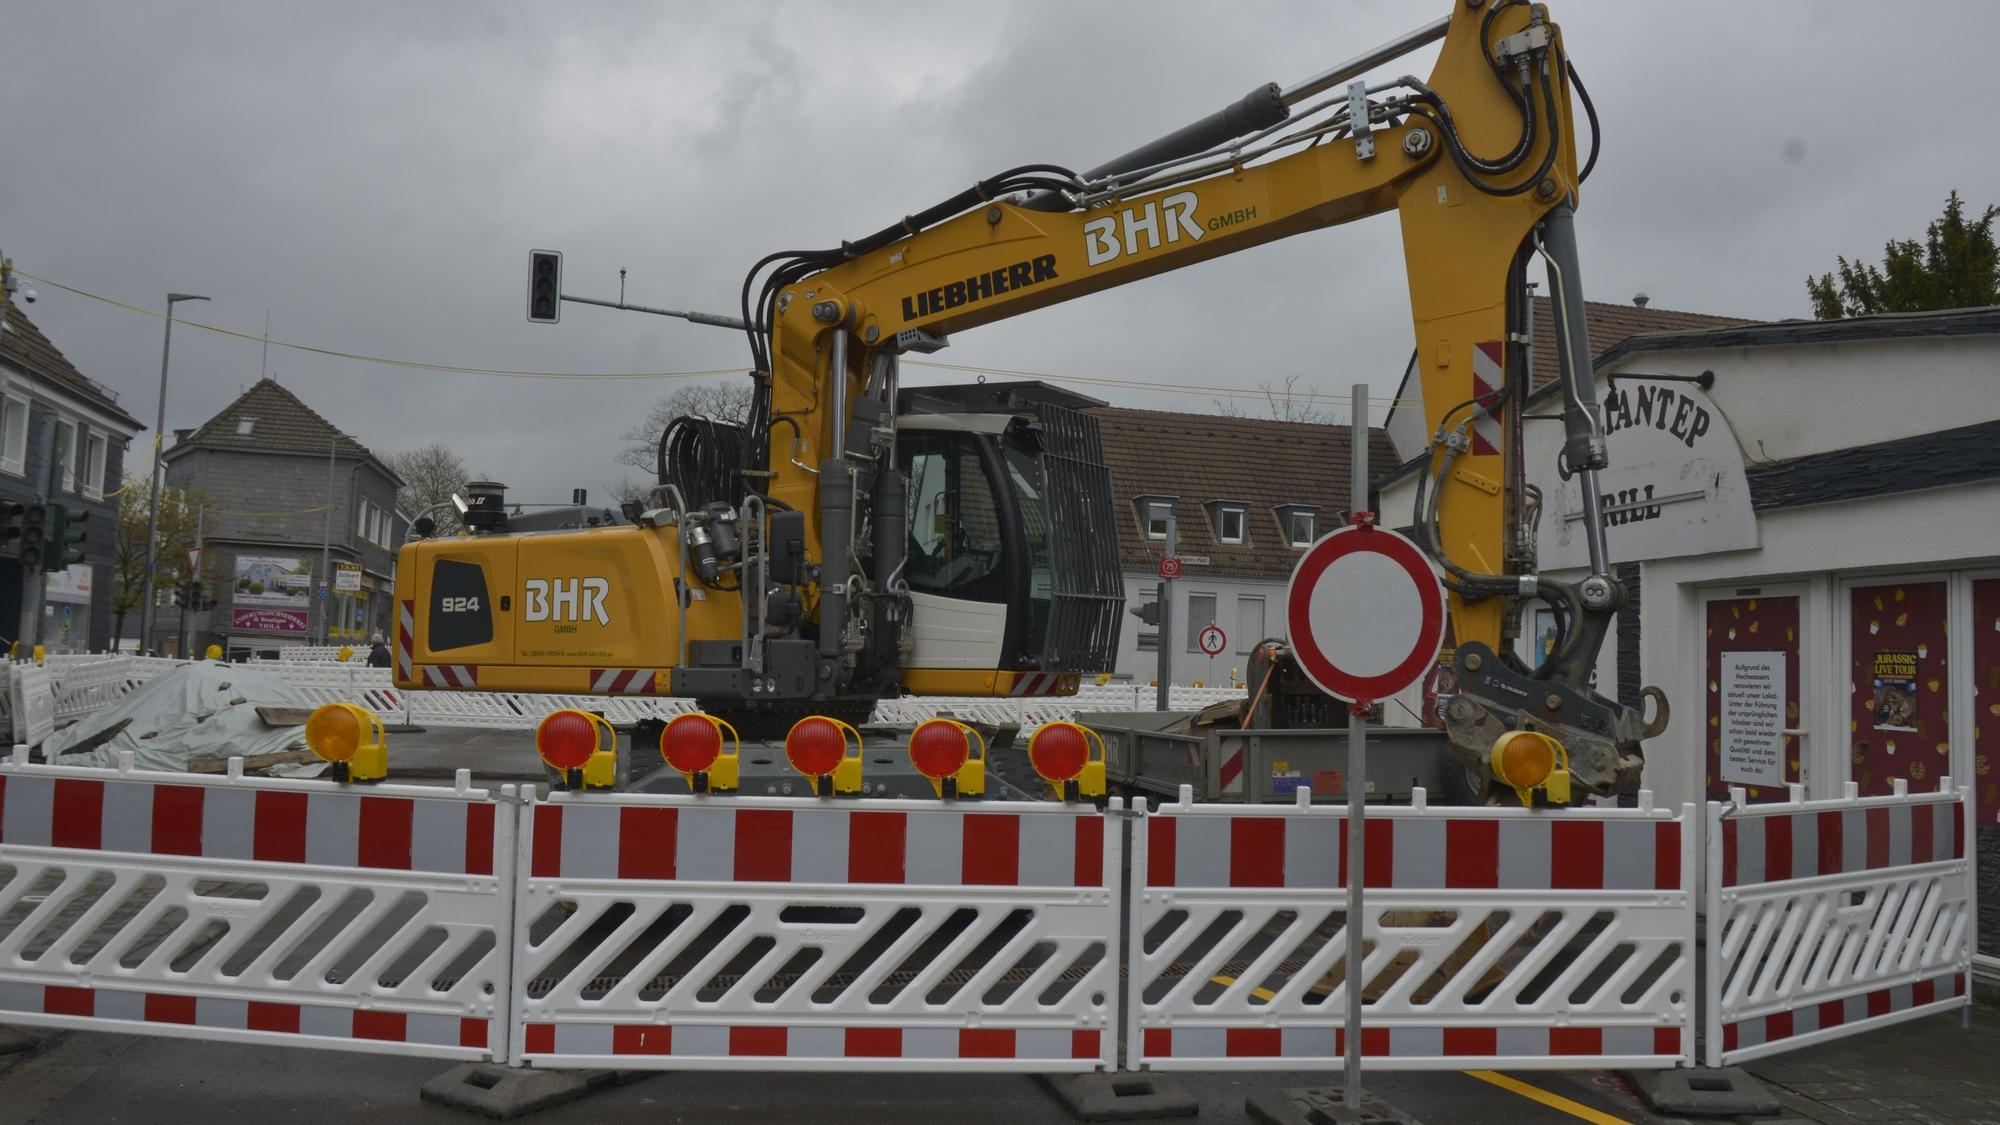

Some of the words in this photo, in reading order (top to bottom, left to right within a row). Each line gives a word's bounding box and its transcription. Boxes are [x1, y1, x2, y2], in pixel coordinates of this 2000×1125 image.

[1084, 191, 1206, 267] BHR
[1207, 206, 1258, 231] GMBH
[902, 255, 1058, 321] LIEBHERR
[1598, 485, 1661, 527] RILL
[442, 597, 480, 613] 924
[524, 577, 610, 627] BHR
[554, 625, 577, 634] GMBH
[1875, 654, 1916, 664] JURASSIC
[1735, 664, 1760, 672] Aufgrund
[1875, 665, 1893, 673] LIVE
[1894, 665, 1916, 674] TOUR
[1733, 682, 1762, 690] renovieren
[1754, 701, 1777, 710] Führung
[1738, 710, 1778, 719] ursprünglichen
[1753, 719, 1764, 727] sind
[1743, 738, 1772, 746] gewohnter
[1729, 746, 1750, 754] Qualität
[1751, 747, 1762, 755] und
[1763, 748, 1776, 756] dem
[1729, 755, 1746, 763] besten
[1747, 756, 1766, 765] Service
[1767, 757, 1776, 766] für
[1741, 766, 1754, 774] euch
